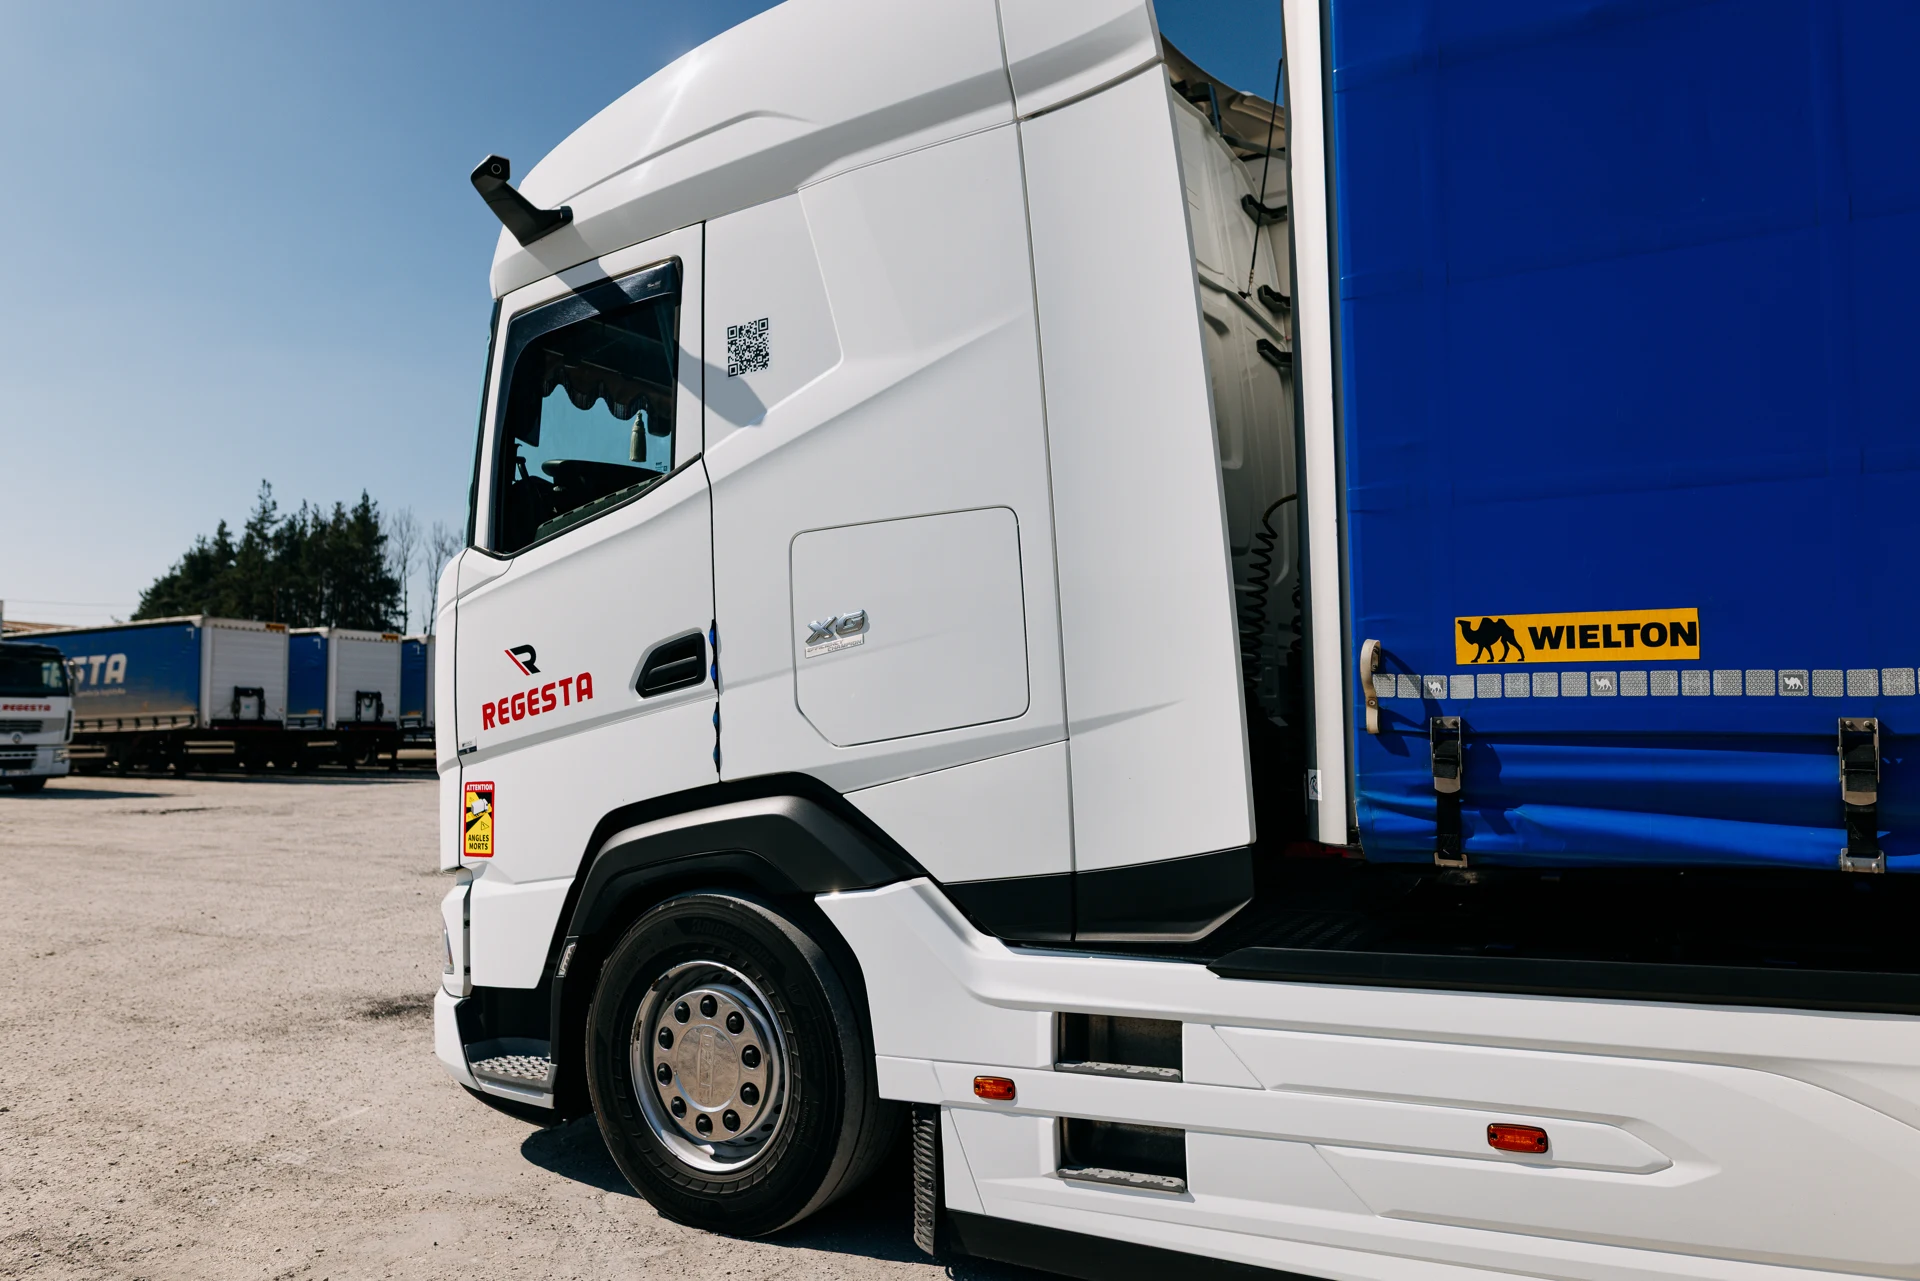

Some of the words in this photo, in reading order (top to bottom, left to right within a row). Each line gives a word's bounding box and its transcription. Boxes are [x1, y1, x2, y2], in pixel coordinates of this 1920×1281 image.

[806, 609, 865, 644] XG
[1527, 620, 1697, 649] WIELTON
[827, 639, 862, 652] CHAMPION
[481, 671, 594, 731] REGESTA
[466, 783, 493, 791] ATTENTION
[467, 834, 490, 842] ANGLES
[468, 842, 489, 851] MORTS
[690, 917, 778, 968] BRIDGESTONE
